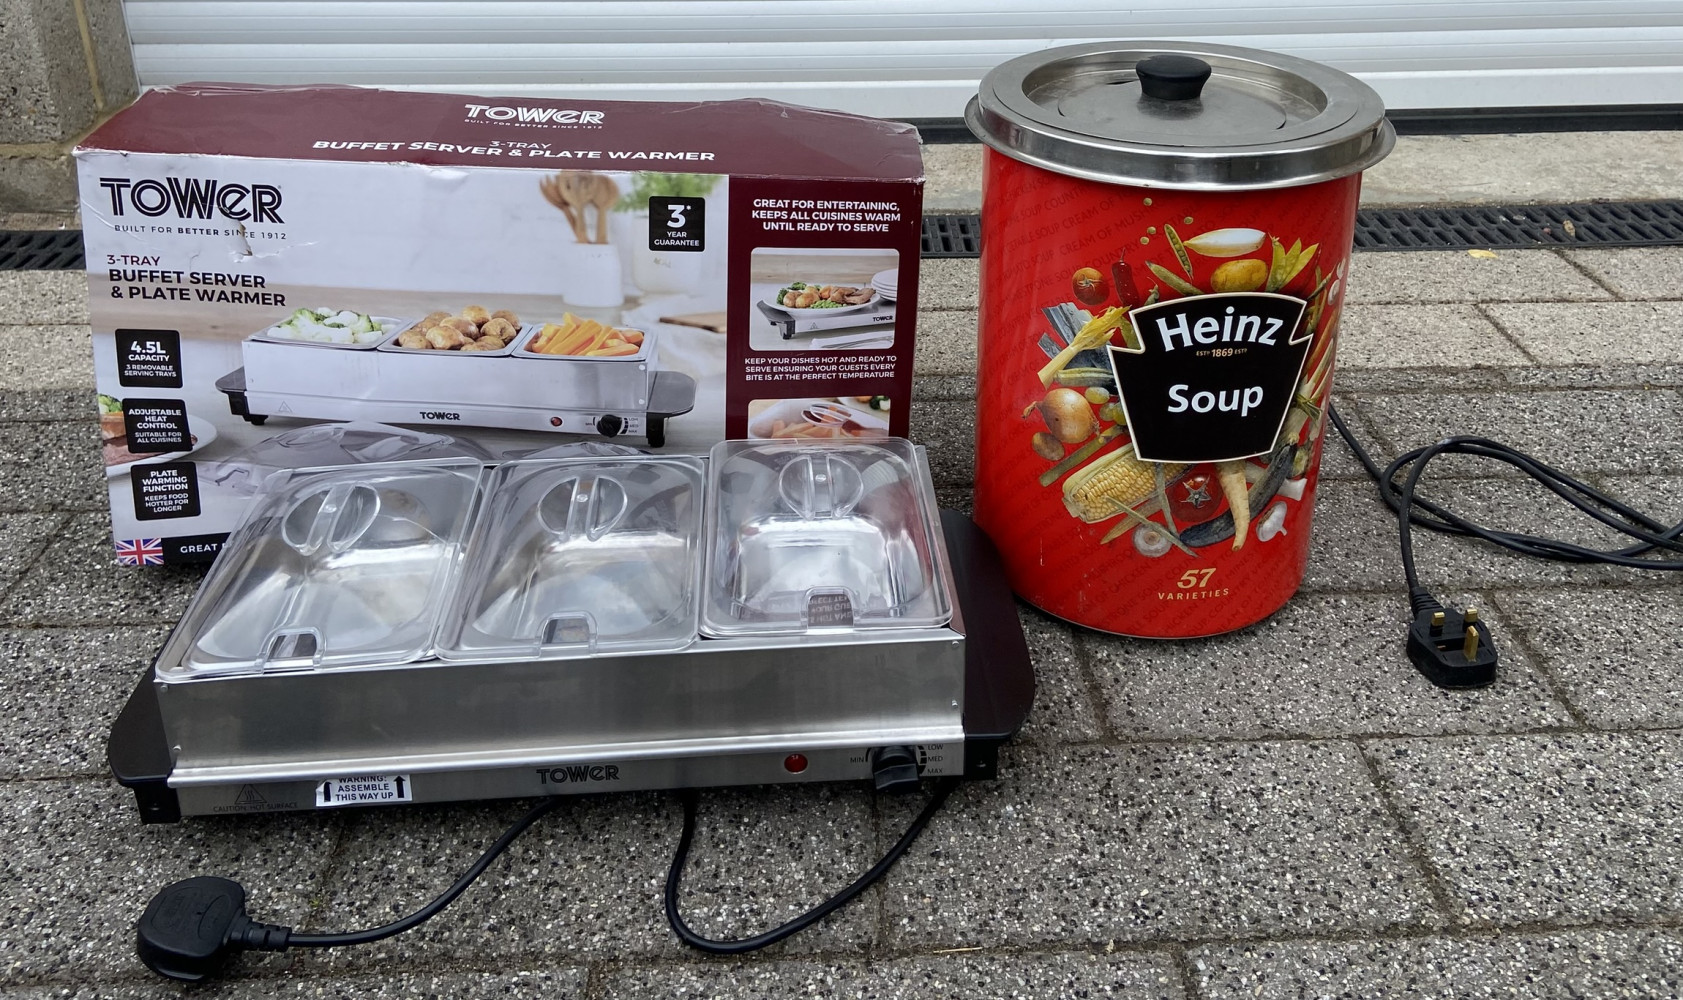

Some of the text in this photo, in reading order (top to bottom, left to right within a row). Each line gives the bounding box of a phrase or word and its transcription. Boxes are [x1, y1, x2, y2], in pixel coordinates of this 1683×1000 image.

[489, 140, 552, 149] 3-TRAY
[312, 140, 716, 162] BUFFET SERVER & PLATE WARMER
[99, 177, 285, 224] TOWER
[753, 199, 900, 212] GREAT FOR ENTERTAINING,
[752, 210, 901, 222] KEEPS ALL CUISINES WARM
[1062, 205, 1099, 229] CREAM
[114, 224, 146, 233] BUILT
[151, 226, 173, 234] FOR
[177, 227, 219, 236] BETTER
[261, 232, 287, 240] 1912
[763, 221, 889, 232] UNTIL READY TO SERVE
[653, 239, 700, 247] GUARANTEE
[1059, 234, 1097, 256] CREAM
[1096, 225, 1113, 240] OF
[106, 254, 161, 267] 3-TRAY
[109, 268, 266, 289] BUFFET SERVER
[111, 285, 286, 307] & PLATE WARMER
[1155, 306, 1284, 352] Heinz
[130, 340, 167, 354] 4.5L
[1211, 347, 1234, 357] 1869
[745, 357, 766, 365] KEEP
[767, 357, 790, 365] YOUR
[821, 356, 838, 364] HOT
[858, 355, 886, 363] READY
[773, 365, 814, 373] ENSURING
[815, 364, 838, 372] YOUR
[802, 372, 837, 380] PERFECT
[838, 371, 895, 379] TEMPERATURE
[1167, 383, 1264, 417] Soup
[128, 408, 182, 416] ADJUSTABLE
[150, 469, 178, 478] PLATE
[142, 476, 188, 486] WARMING
[143, 483, 189, 493] FUNCTION
[144, 494, 168, 502] KEEPS
[145, 498, 189, 508] HOTTER FOR
[153, 505, 182, 513] LONGER
[180, 543, 218, 554] GREAT
[1176, 567, 1217, 589] 57
[1157, 588, 1230, 600] VARIETIES
[536, 765, 620, 785] TOWER
[338, 783, 390, 792] ASSEMBLE
[335, 791, 394, 802] THIS WAY UP
